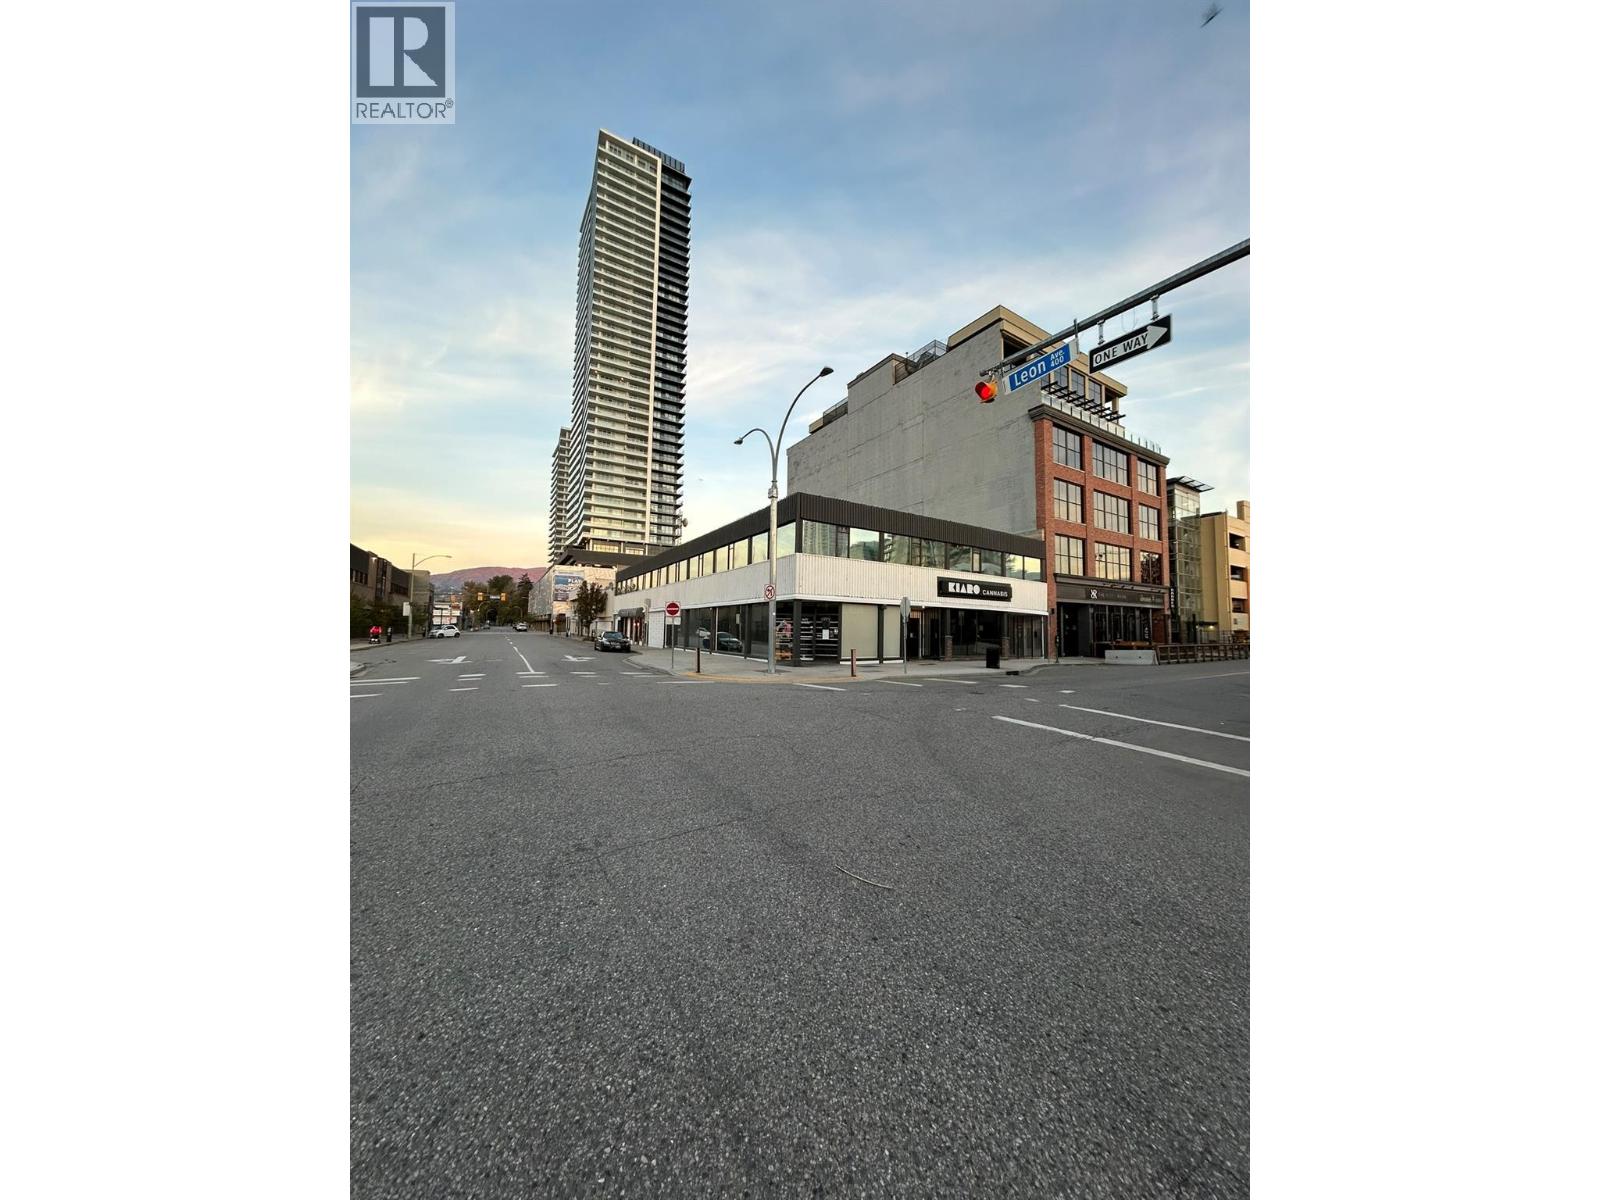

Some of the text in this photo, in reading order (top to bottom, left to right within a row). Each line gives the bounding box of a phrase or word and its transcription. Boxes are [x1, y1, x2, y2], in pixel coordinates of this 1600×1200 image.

[1095, 333, 1148, 364] ONE WAY
[1050, 355, 1065, 367] 400
[1014, 360, 1046, 386] Leon
[948, 582, 1008, 598] KIARO CANNABIS
